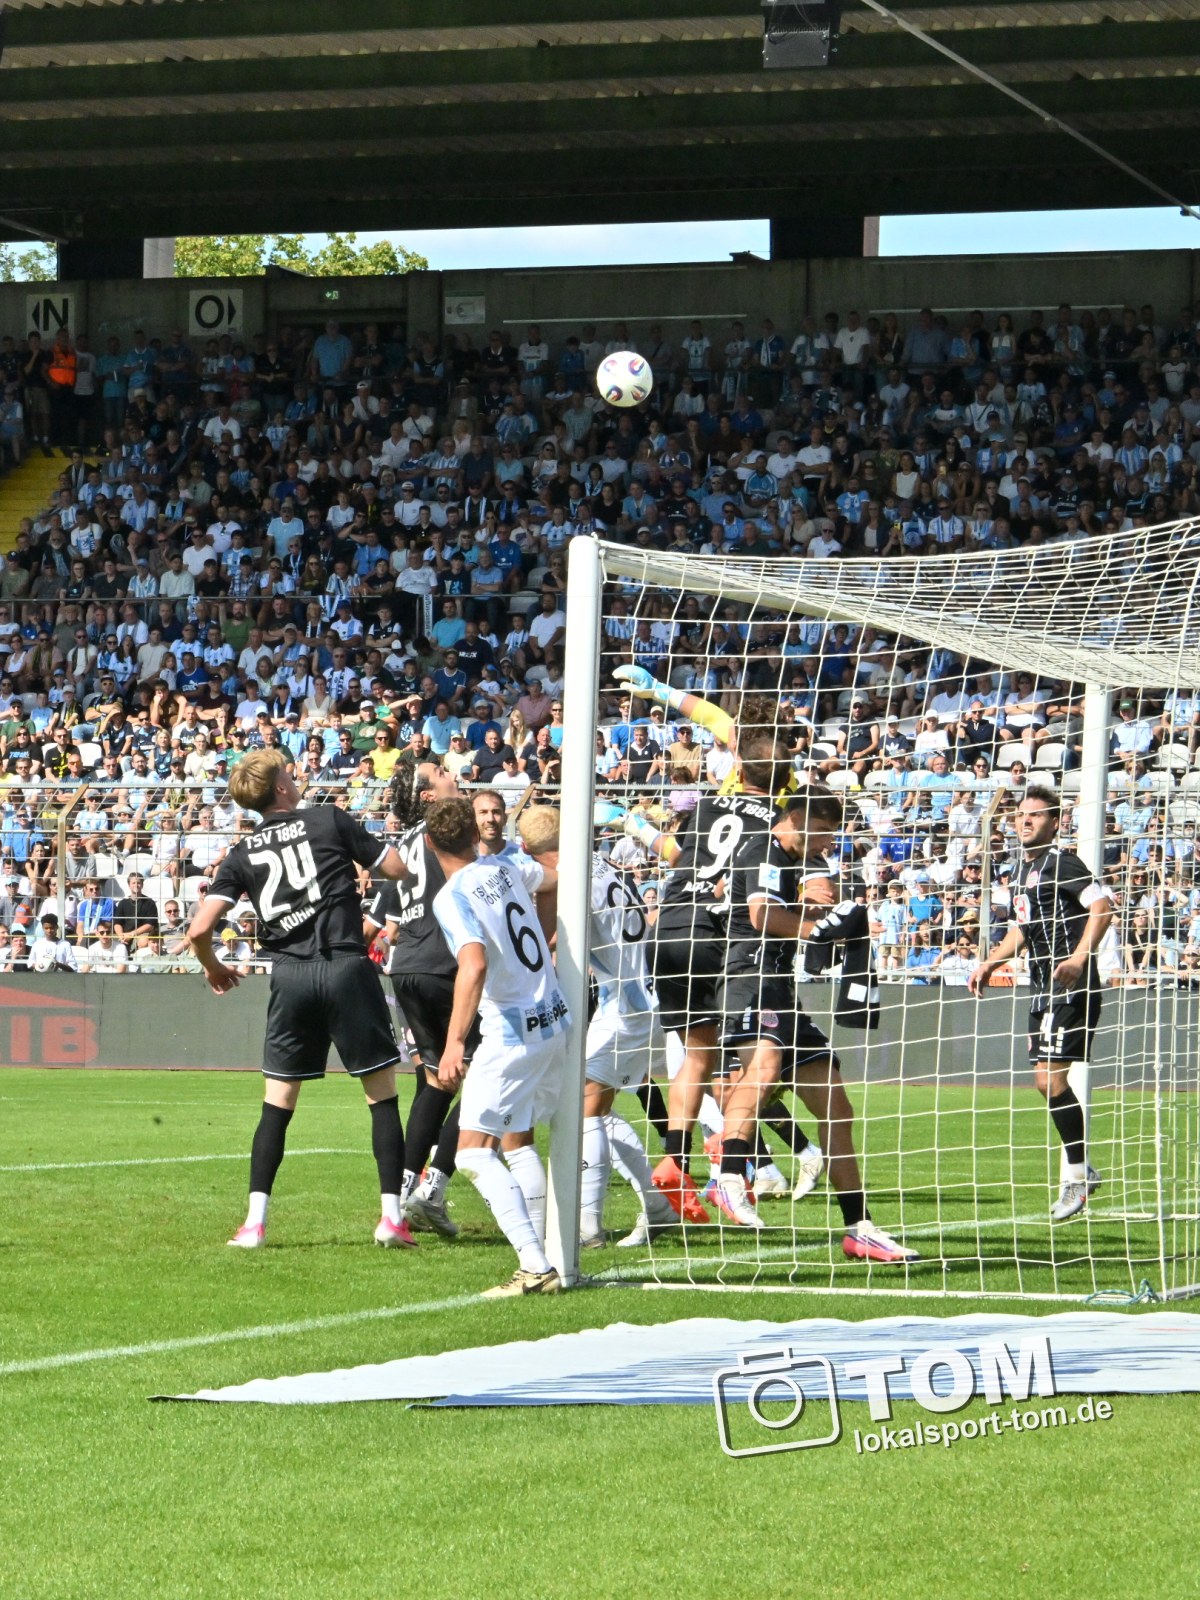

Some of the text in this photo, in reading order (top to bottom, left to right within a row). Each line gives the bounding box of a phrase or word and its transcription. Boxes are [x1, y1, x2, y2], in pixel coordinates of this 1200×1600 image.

[43, 298, 69, 330] N
[194, 294, 225, 329] O
[712, 796, 776, 823] TSV 1882
[244, 820, 307, 850] TSV 1882
[696, 814, 744, 879] 9
[248, 840, 322, 922] 24
[279, 904, 316, 932] KUHN
[400, 903, 425, 925] AUER
[505, 901, 544, 973] 6
